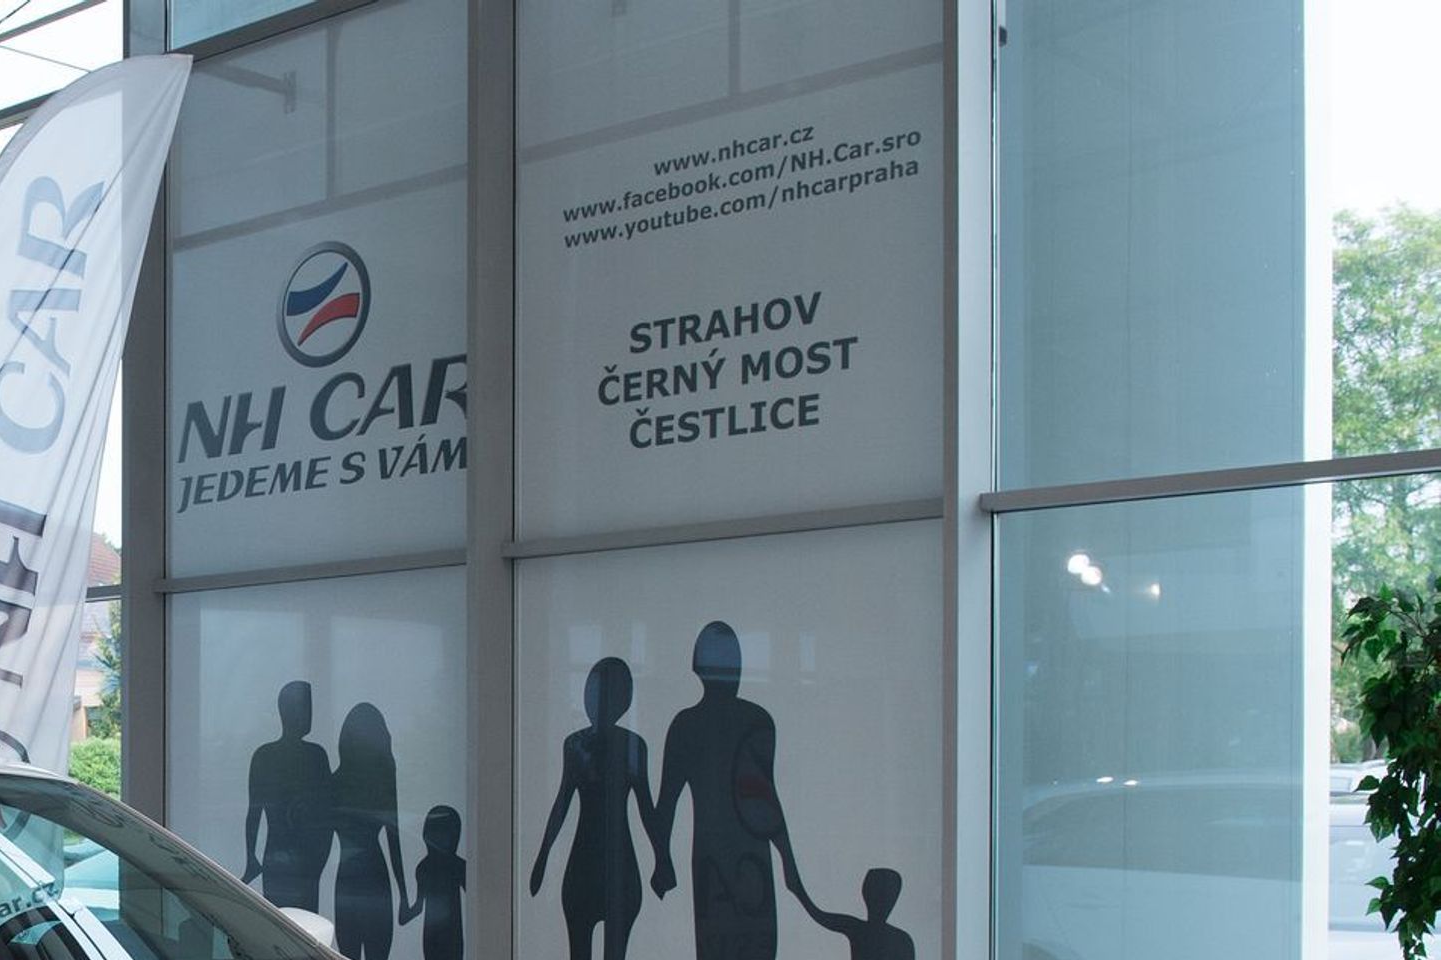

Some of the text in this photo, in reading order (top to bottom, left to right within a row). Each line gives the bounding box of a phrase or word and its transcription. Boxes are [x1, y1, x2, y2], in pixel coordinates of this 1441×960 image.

[563, 129, 922, 223] www.facebook.com/NH.Car.sro
[653, 125, 815, 176] www.nhcar.cz
[564, 158, 920, 248] www.youtube.com/nhcarpraha
[629, 291, 822, 354] STRAHOV
[177, 353, 468, 464] NH CAR
[597, 336, 859, 406] ČERNÝ MOST
[629, 393, 821, 449] ČESTLICE
[177, 434, 468, 514] JEDEME S VÁM
